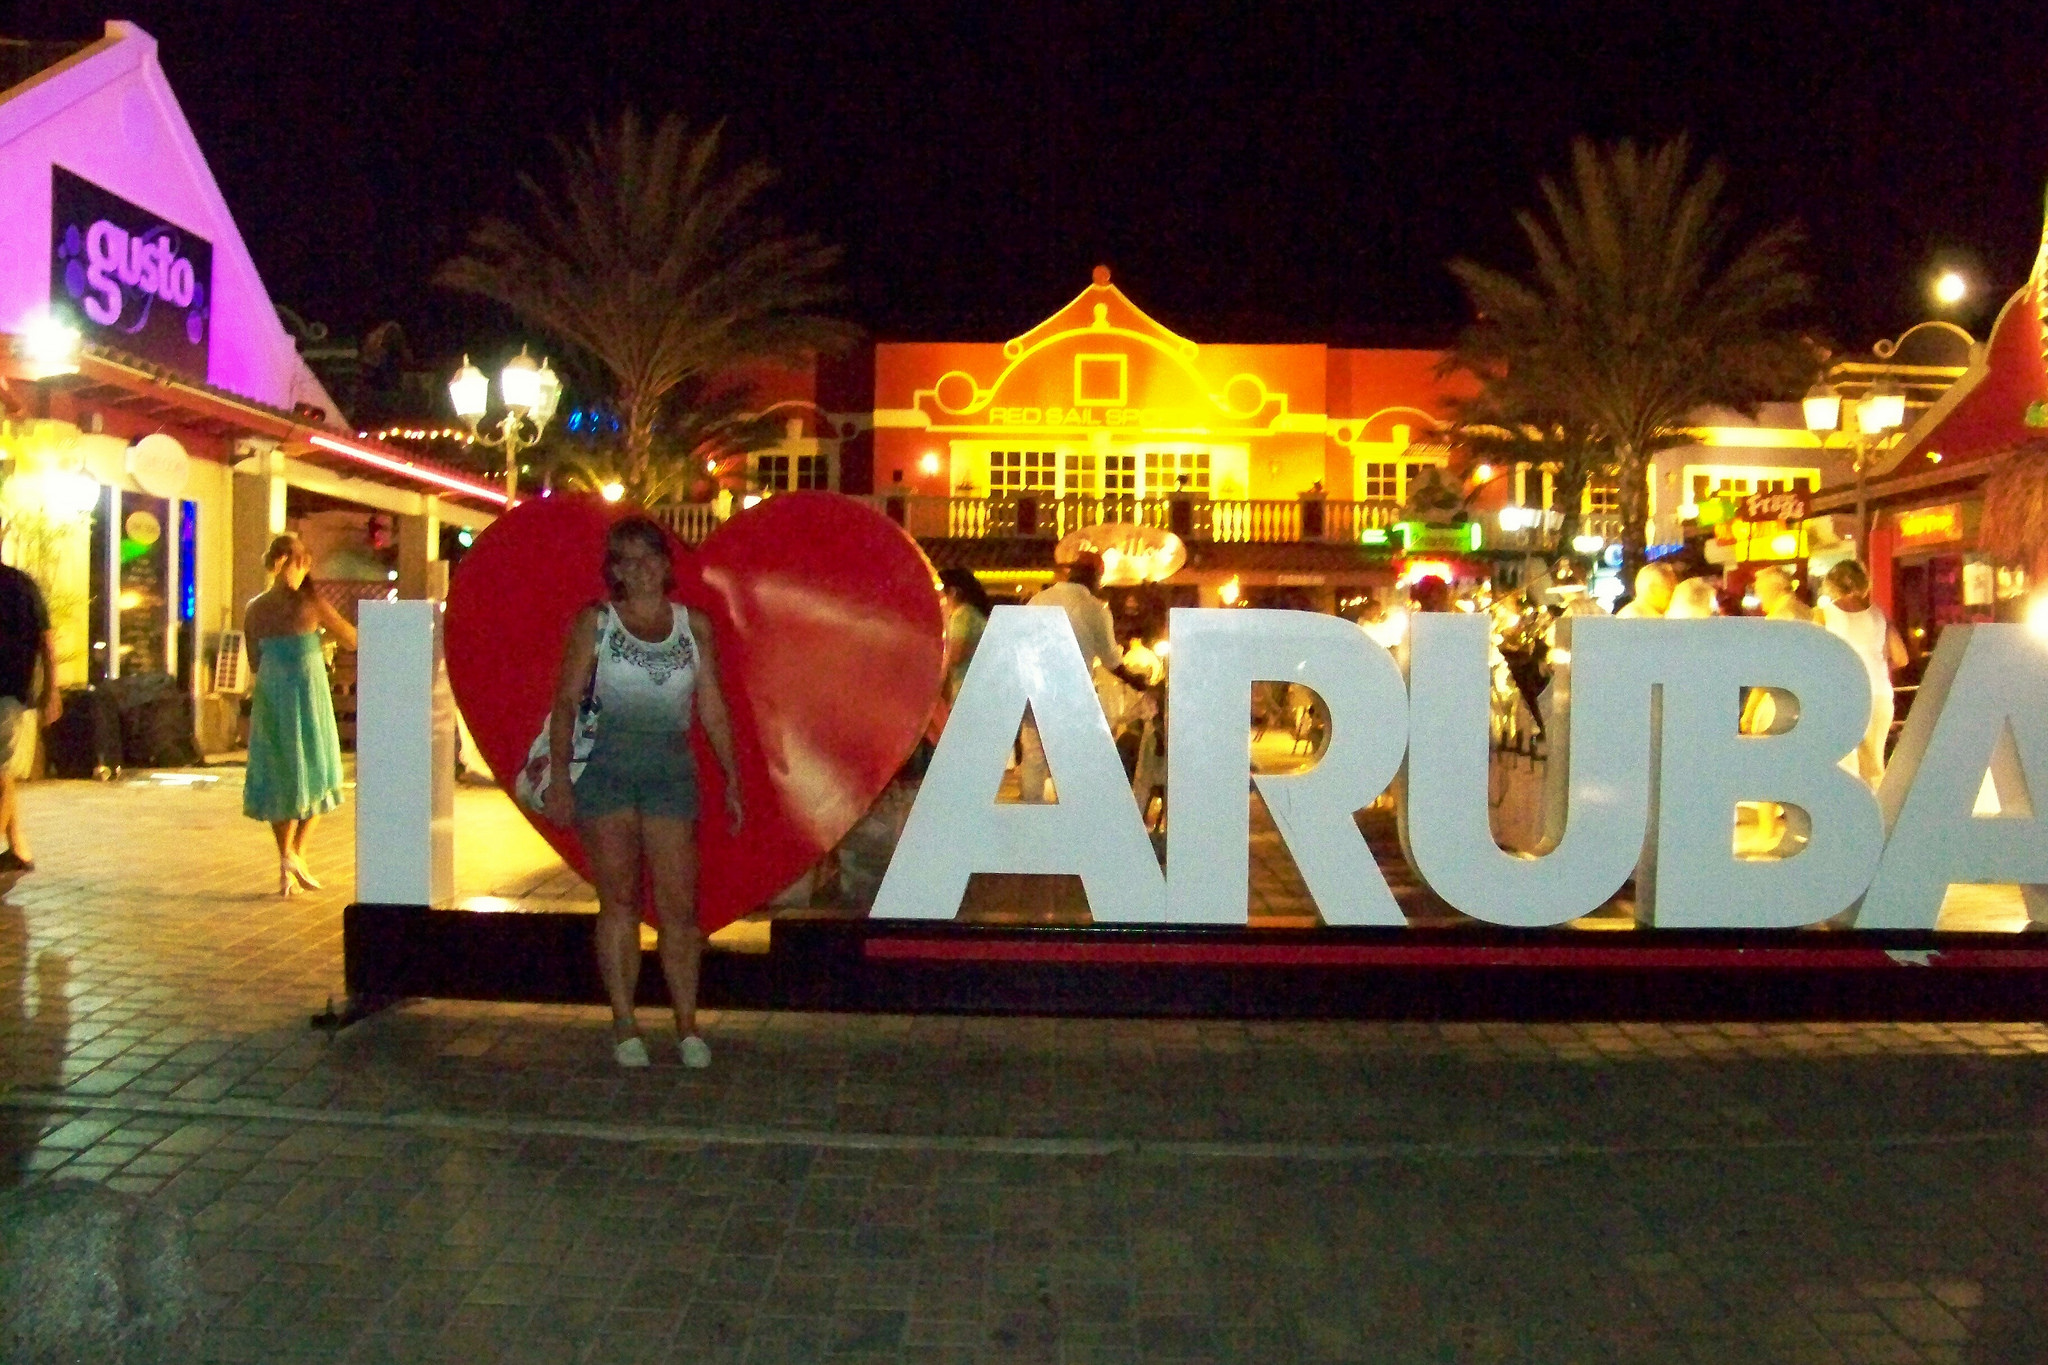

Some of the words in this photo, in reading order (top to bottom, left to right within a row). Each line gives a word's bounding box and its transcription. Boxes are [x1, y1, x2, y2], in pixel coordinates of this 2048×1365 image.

[85, 219, 195, 327] gusto
[989, 407, 1042, 425] RED
[1045, 407, 1101, 425] SAIL
[355, 599, 434, 906] I
[868, 603, 2048, 931] ARUBA
